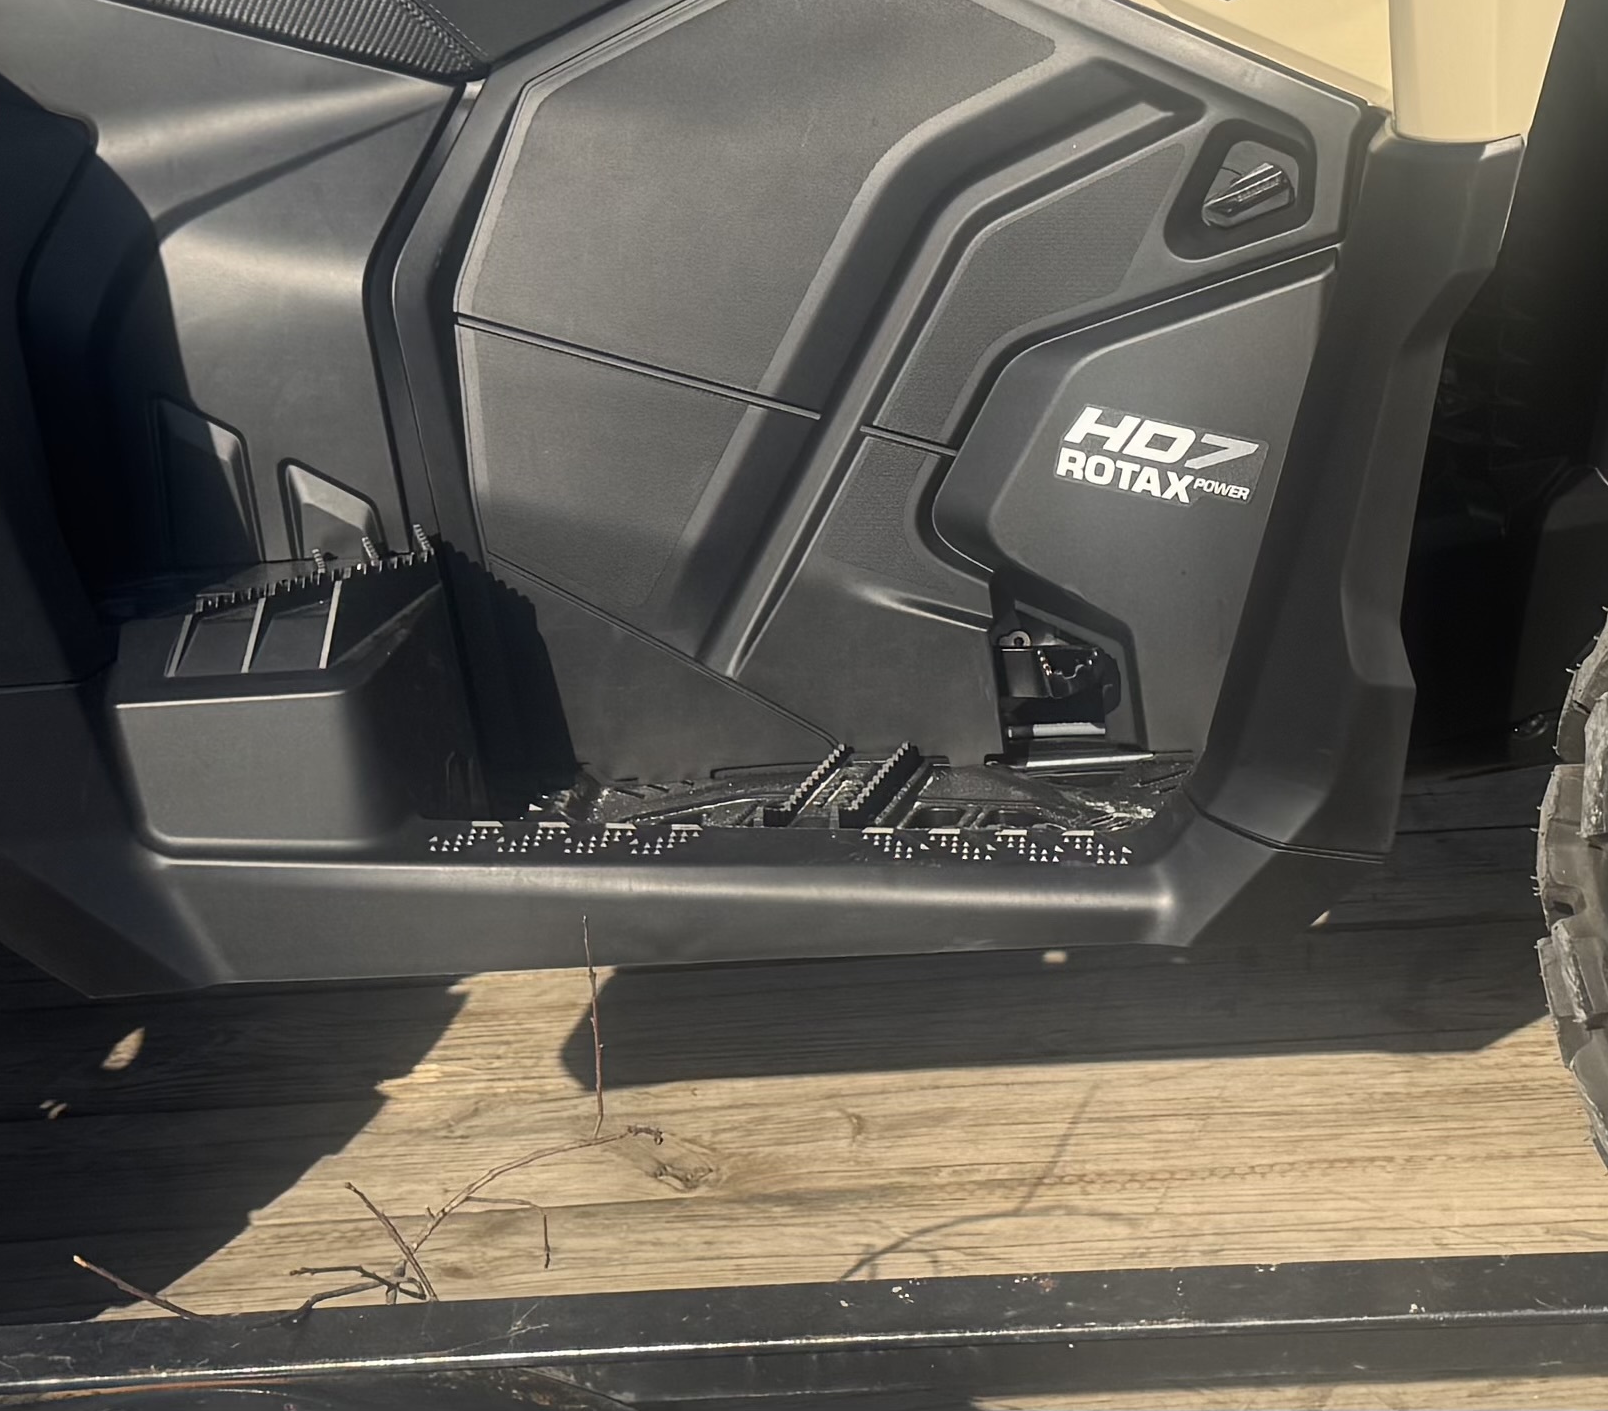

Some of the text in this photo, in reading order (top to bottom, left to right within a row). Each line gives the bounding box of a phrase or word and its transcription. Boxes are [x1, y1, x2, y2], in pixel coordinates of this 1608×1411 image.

[1063, 406, 1260, 470] HD7
[1055, 446, 1251, 504] ROTAX POWER
